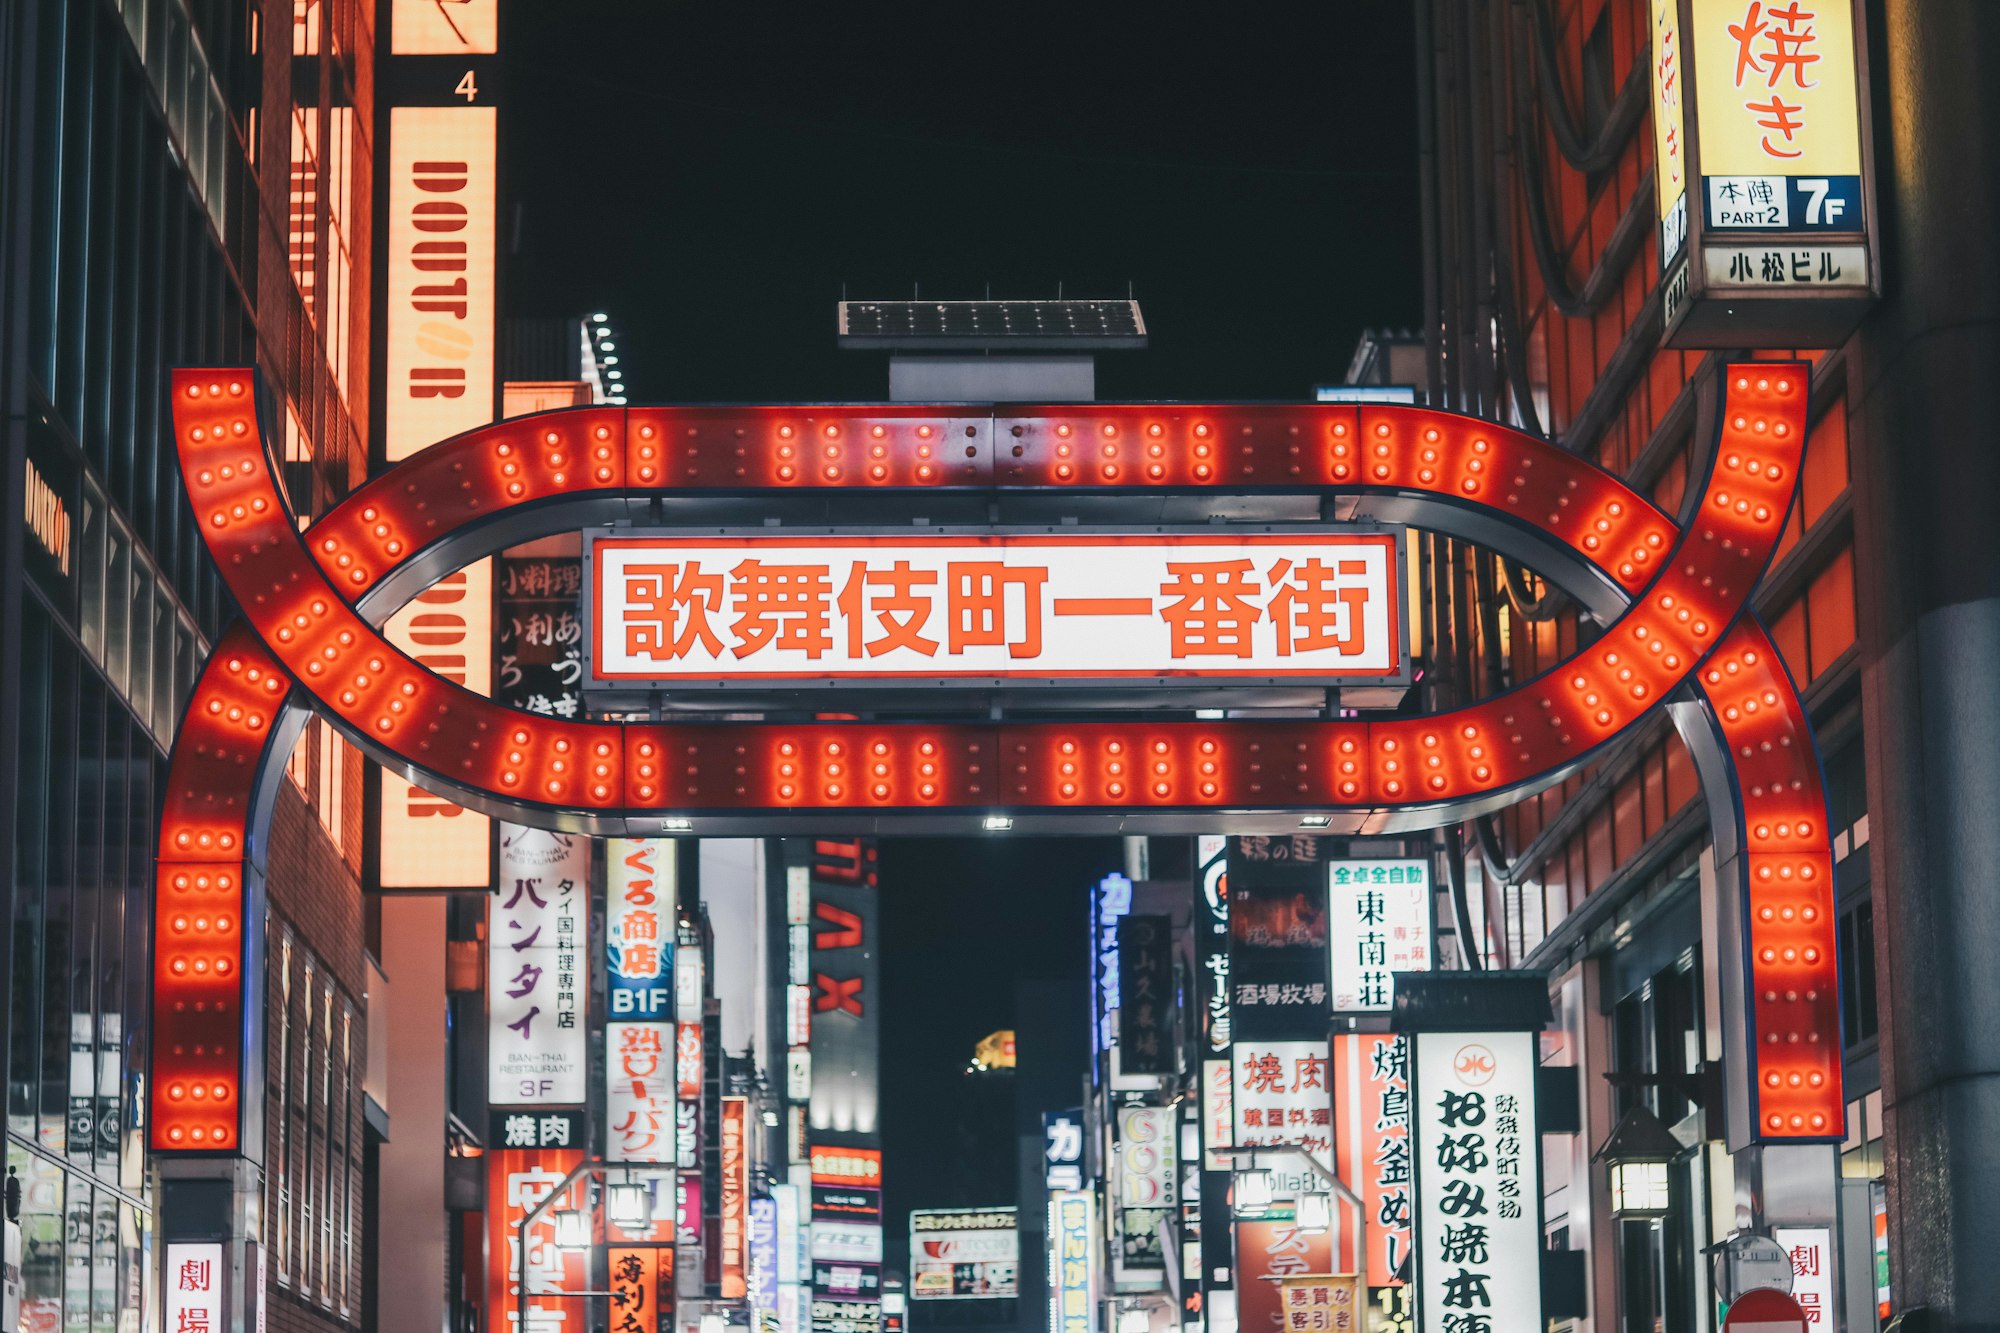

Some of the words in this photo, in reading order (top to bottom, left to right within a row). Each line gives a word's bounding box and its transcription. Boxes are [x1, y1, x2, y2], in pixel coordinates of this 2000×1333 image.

[454, 70, 478, 102] 4
[1727, 1, 1821, 158] 焼き
[1719, 180, 1774, 206] 本陣
[1796, 179, 1846, 225] 7F
[1721, 207, 1780, 224] PART2
[409, 161, 474, 399] DOUTOR
[1730, 252, 1841, 282] 小松ビル
[622, 557, 1371, 661] 歌舞伎町一番街
[1335, 866, 1423, 885] 全卓全自動
[623, 838, 660, 975] ぐろ商店
[1356, 891, 1388, 1007] 東南荘
[1410, 890, 1425, 972] リーチ麻
[502, 877, 548, 1040] バンタイ
[556, 878, 575, 1029] タイ国料理専門店
[612, 988, 669, 1013] B1F
[520, 1079, 554, 1097] 3F
[1243, 1052, 1330, 1094] 焼肉
[505, 1115, 570, 1147] 焼肉
[178, 1259, 211, 1333] 劇場
[1291, 1288, 1349, 1307] 悪質な
[1291, 1311, 1350, 1330] 客引き
